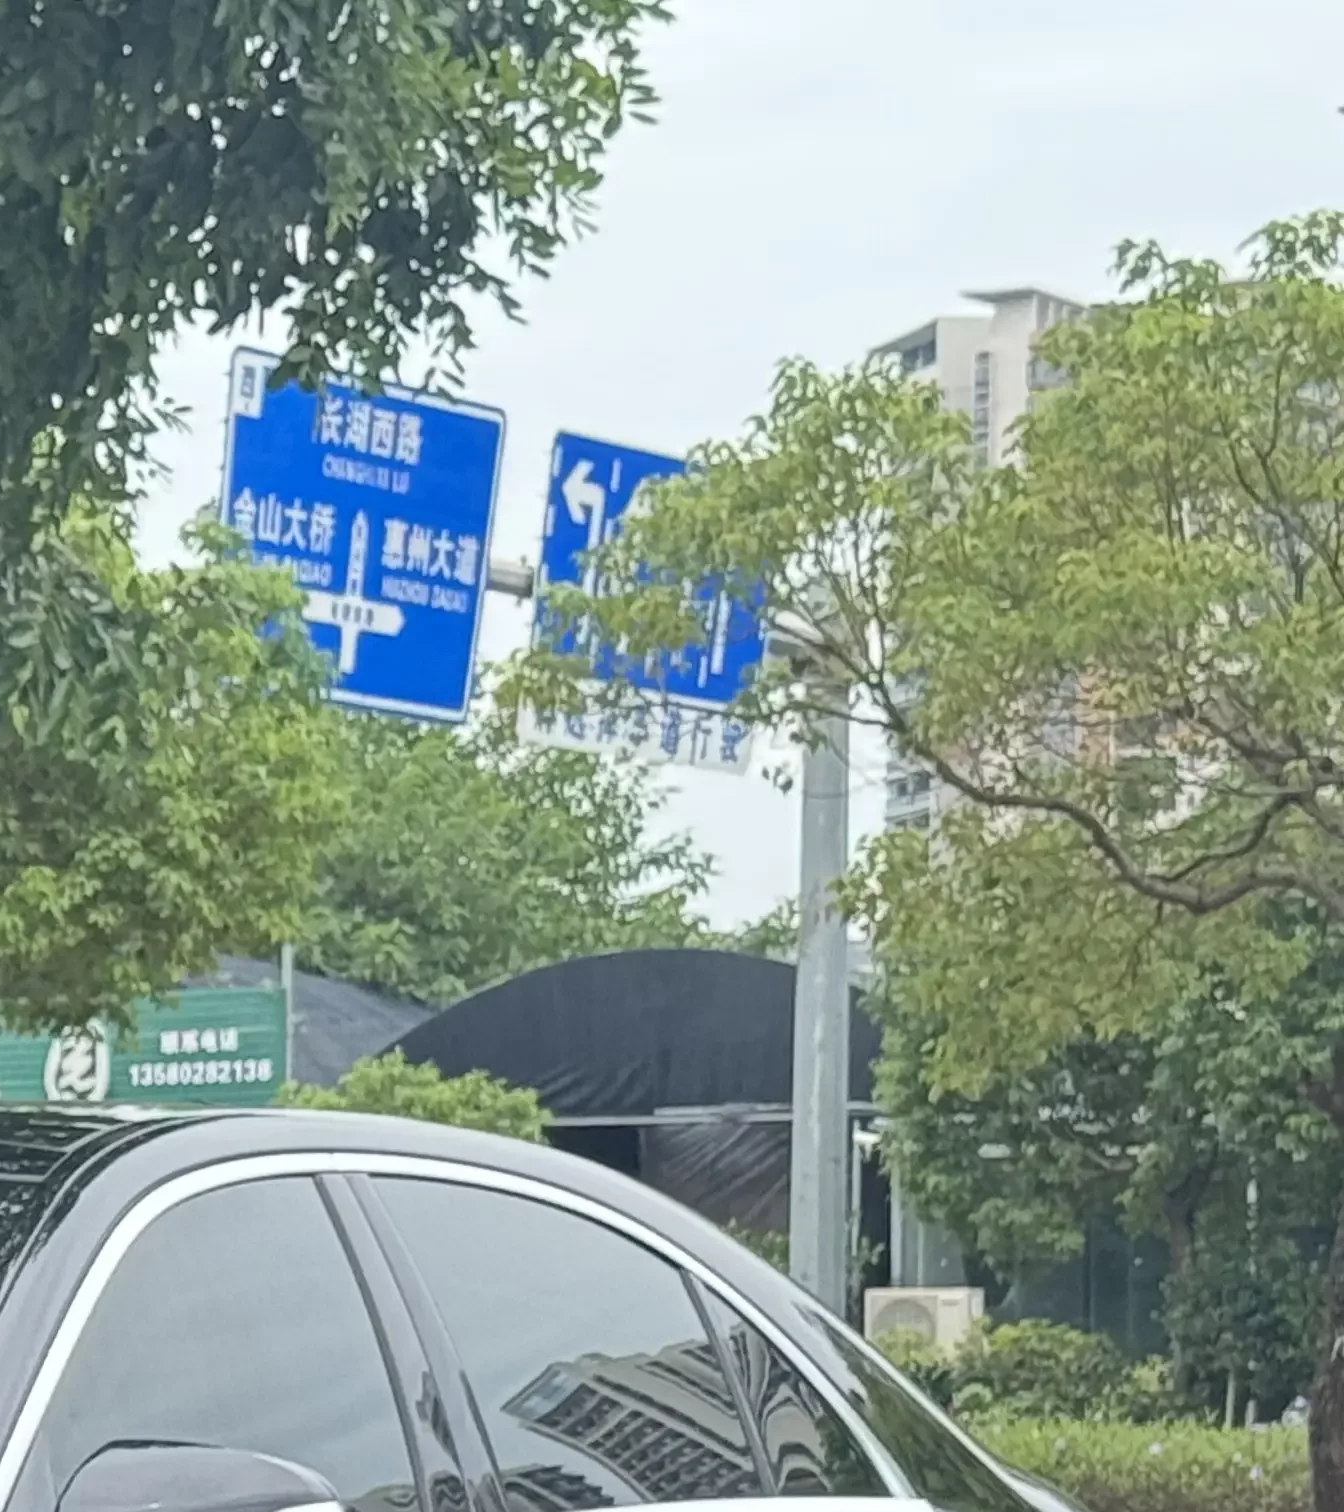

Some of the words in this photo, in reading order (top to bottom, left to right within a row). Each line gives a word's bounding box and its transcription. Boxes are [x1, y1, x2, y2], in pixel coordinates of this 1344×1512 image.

[320, 391, 423, 466] 长湖西路
[233, 486, 337, 556] 金山大桥
[381, 516, 480, 586] 惠州大道
